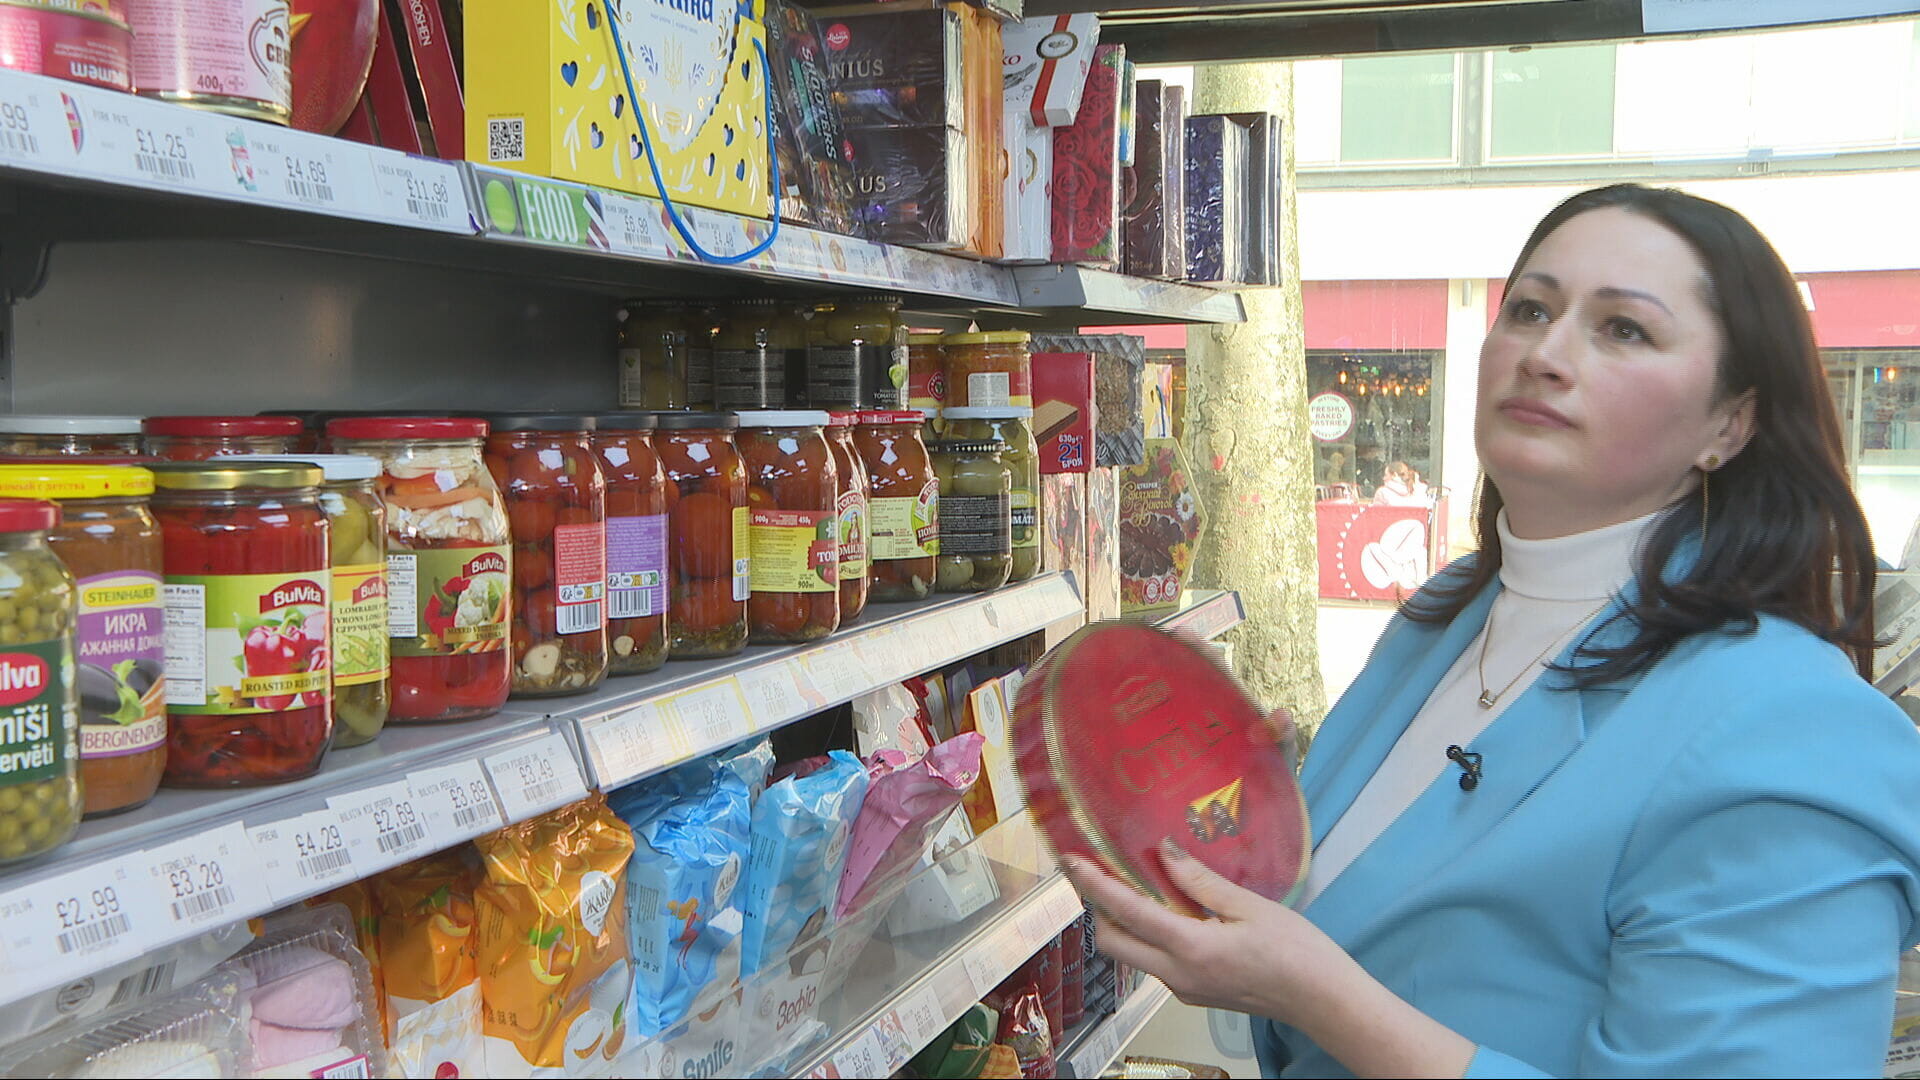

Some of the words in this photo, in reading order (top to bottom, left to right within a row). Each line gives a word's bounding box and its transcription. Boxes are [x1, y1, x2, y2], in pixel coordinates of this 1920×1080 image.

[800, 46, 837, 160] SHOOTERS
[136, 128, 188, 160] £1.25
[285, 156, 328, 184] £4.69
[521, 183, 579, 244] FOOD
[1059, 442, 1083, 462] 21
[1062, 457, 1084, 470] БРОЯ
[471, 557, 505, 574] BulVita
[88, 588, 156, 604] STEINHAUER
[273, 588, 322, 607] BulVita
[797, 580, 815, 589] 900ml
[105, 612, 148, 635] ИКРА
[80, 637, 135, 656] АЖАННАЯ
[245, 679, 293, 693] ROASTED
[295, 677, 311, 689] RED
[519, 758, 554, 786] £3.49
[450, 780, 488, 810] £3.89
[373, 801, 416, 834] £2.69
[295, 824, 343, 857] £4.29
[170, 860, 224, 898] £3.20
[56, 886, 120, 929] £2.99
[683, 1039, 734, 1079] Smile
